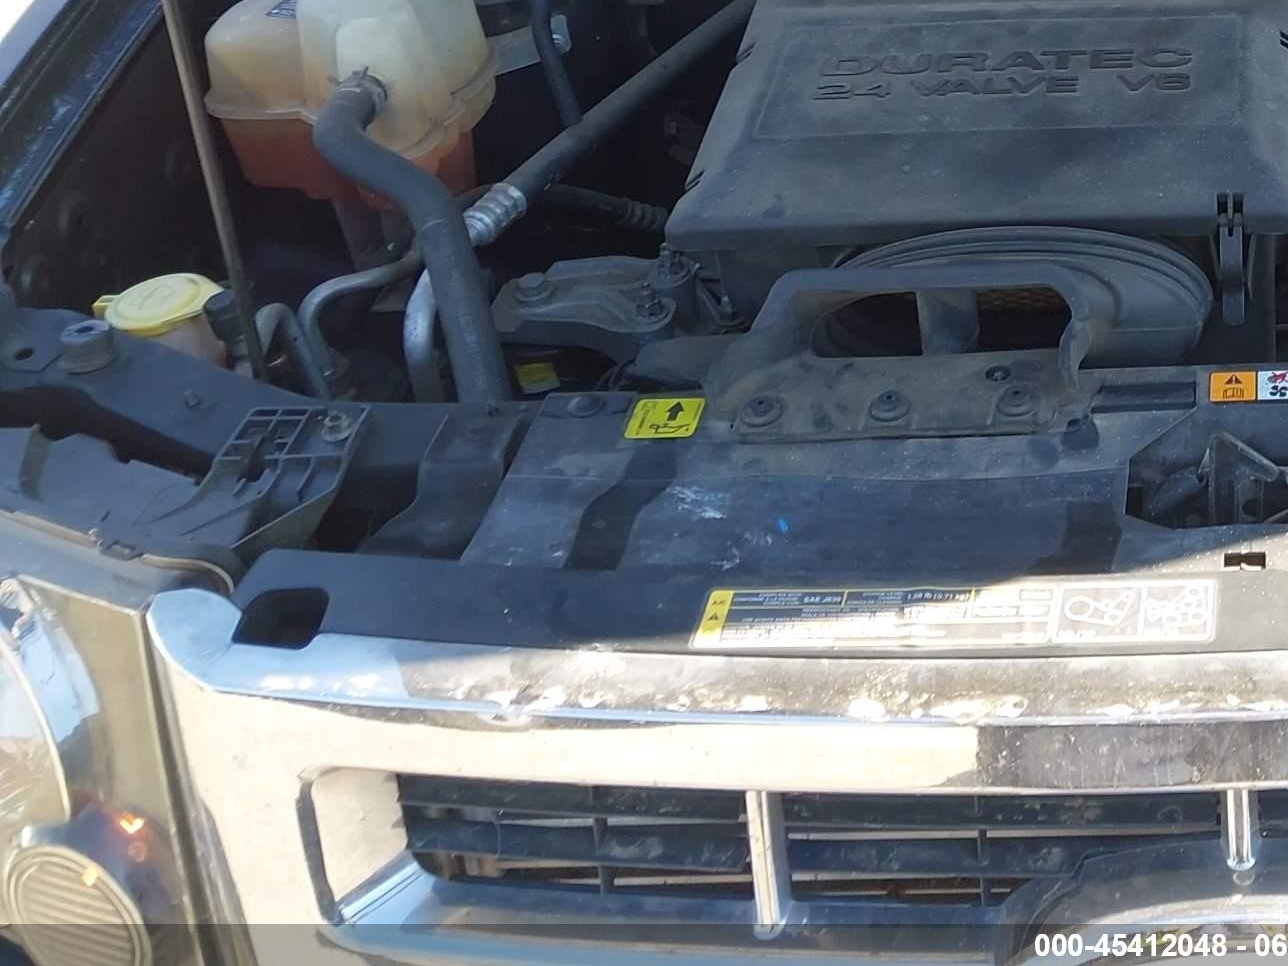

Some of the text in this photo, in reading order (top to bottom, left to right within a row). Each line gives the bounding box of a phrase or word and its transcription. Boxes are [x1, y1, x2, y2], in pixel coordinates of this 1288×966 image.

[819, 47, 1193, 77] DURATEC
[812, 72, 1192, 101] 24 VALVE V6
